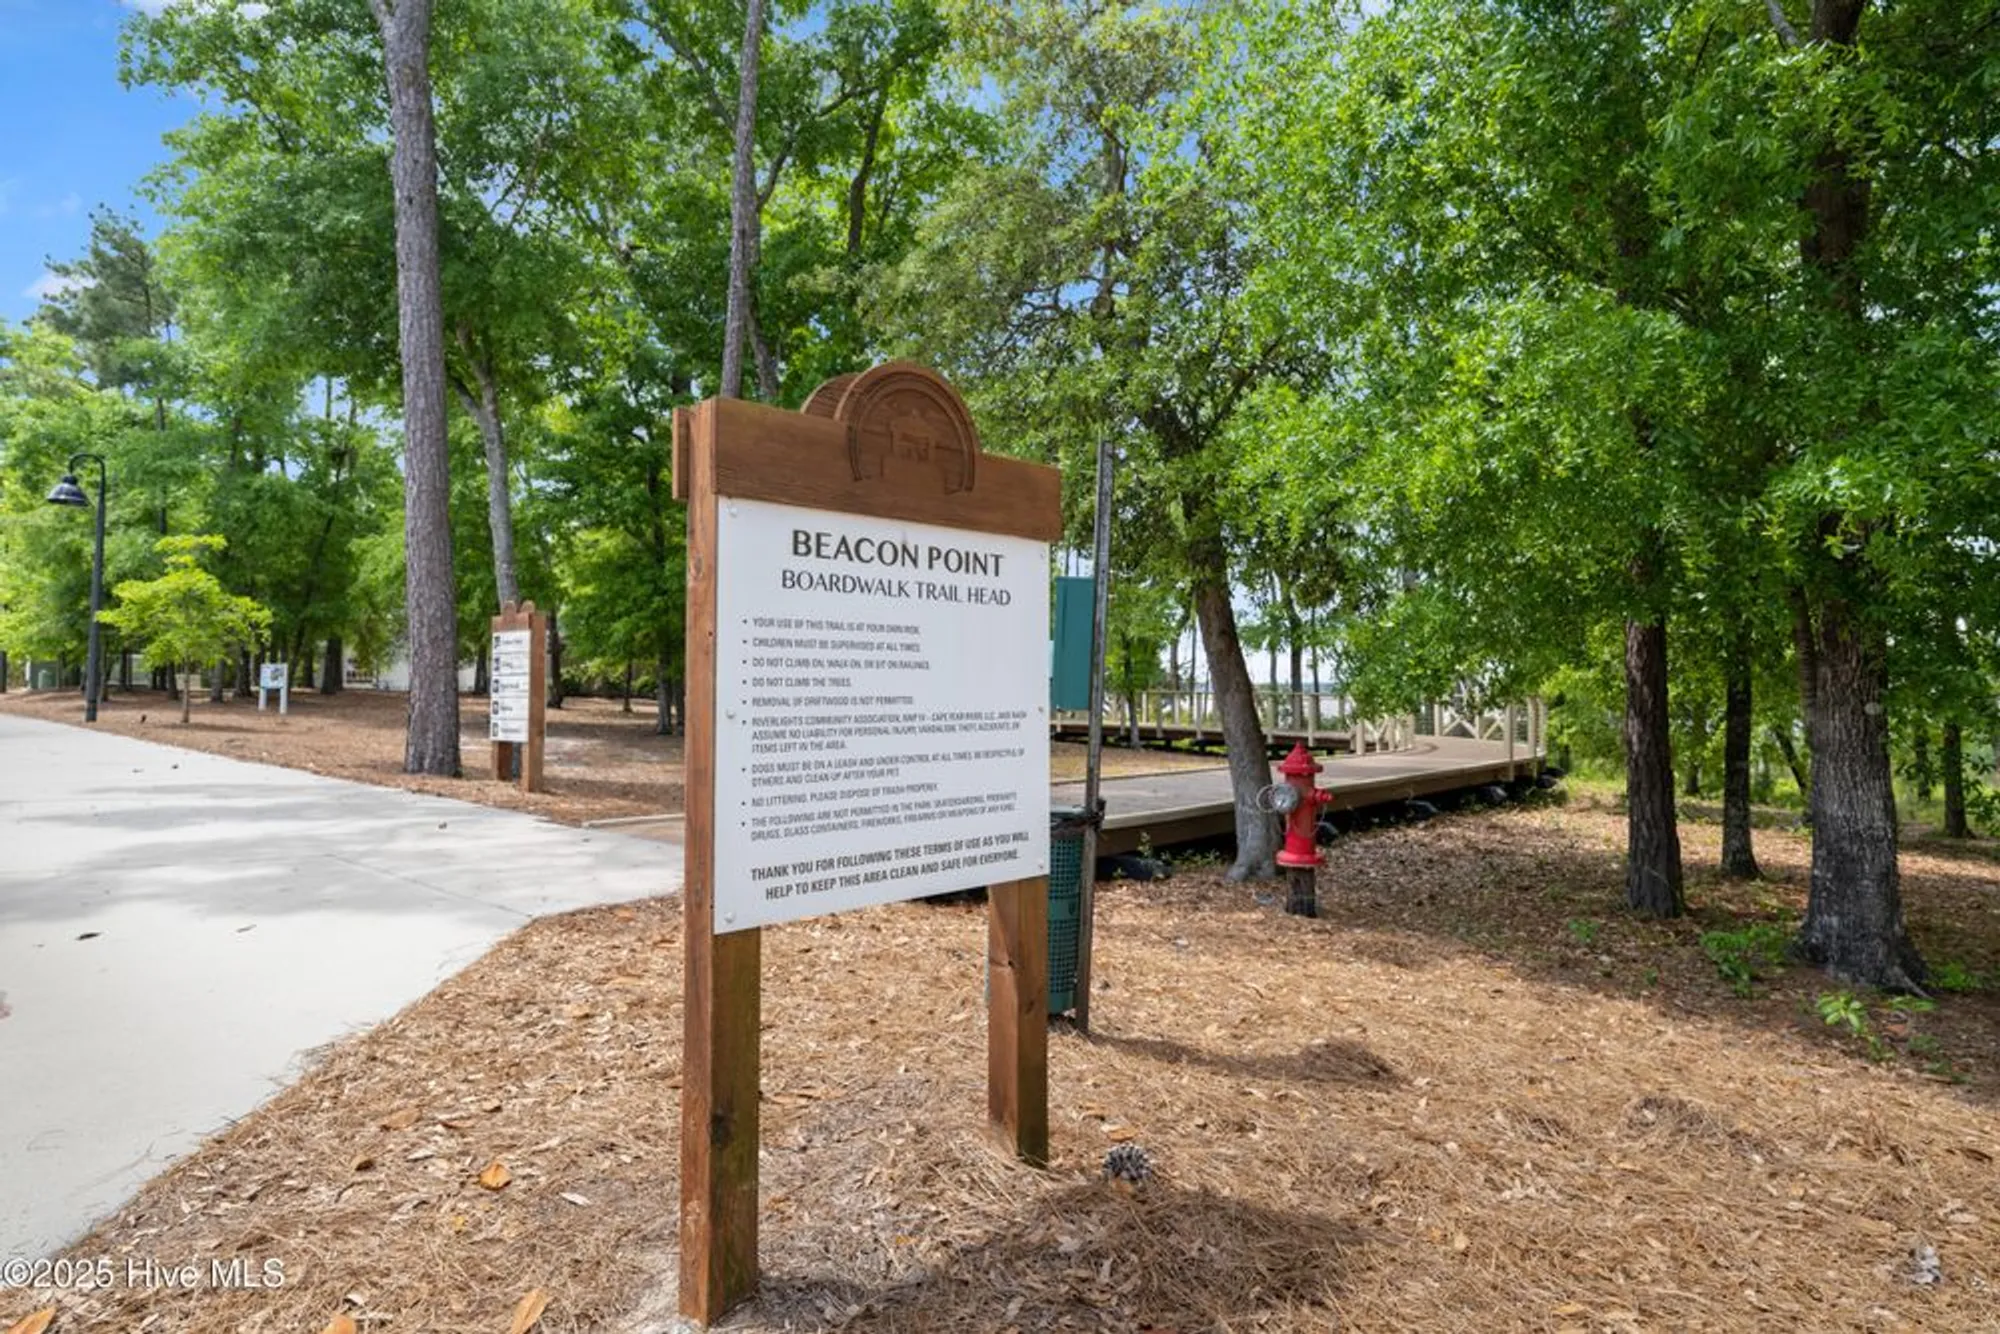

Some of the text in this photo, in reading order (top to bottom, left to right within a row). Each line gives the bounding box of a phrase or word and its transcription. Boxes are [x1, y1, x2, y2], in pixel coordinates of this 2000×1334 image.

[791, 528, 1004, 578] BEACON POINT
[781, 568, 1011, 606] BOARDWALK TRAIL HEAD
[752, 616, 774, 628] YOUR
[776, 617, 792, 628] USE
[793, 618, 803, 629] OF
[805, 619, 822, 630] THIS
[825, 620, 845, 631] TRAIL
[846, 621, 854, 631] IS
[855, 622, 864, 632] AT
[866, 622, 884, 633] YOUR
[885, 623, 903, 633] OWN
[752, 636, 792, 648] CHILDREN
[793, 638, 817, 648] MUST
[818, 639, 828, 649] BE
[829, 639, 874, 650] SUPERVISED
[876, 641, 884, 651] AT
[886, 641, 898, 651] ALL
[752, 656, 764, 667] DO
[766, 656, 783, 667] NOT
[784, 657, 810, 668] CLIMB
[825, 658, 848, 668] WALK
[864, 659, 873, 668] OR
[875, 659, 885, 669] SIT
[887, 659, 896, 669] ON
[752, 676, 764, 687] DO
[765, 676, 783, 687] NOT
[784, 676, 810, 687] CLIMB
[811, 677, 825, 687] THE
[752, 696, 790, 707] REMOVAL
[792, 696, 803, 706] OF
[803, 695, 849, 706] DRIFTWOOD
[850, 695, 858, 705] IS
[859, 695, 873, 705] NOT
[752, 715, 803, 726] RIVERLIGHTS
[804, 714, 852, 725] COMMUNITY
[931, 712, 947, 721] CAPE
[751, 729, 786, 740] ASSUME
[788, 728, 800, 739] NO
[802, 727, 838, 738] LIABILITY
[838, 727, 852, 737] FOR
[853, 726, 890, 736] PERSONAL
[751, 742, 777, 754] ITEMS
[779, 741, 797, 752] LEFT
[798, 741, 808, 751] IN
[809, 740, 823, 751] THE
[751, 762, 775, 774] DOGS
[777, 761, 800, 772] MUST
[802, 760, 811, 770] BE
[813, 759, 825, 770] ON
[826, 759, 833, 769] A
[834, 757, 857, 768] LEASH
[858, 756, 874, 767] AND
[876, 755, 899, 765] UNDER
[931, 753, 940, 762] AT
[940, 752, 951, 761] ALL
[751, 775, 784, 787] OTHERS
[785, 774, 802, 784] AND
[804, 772, 829, 783] CLEAN
[830, 771, 841, 781] UP
[843, 769, 865, 780] AFTER
[866, 768, 885, 778] YOUR
[751, 796, 764, 807] NO
[809, 790, 837, 801] PLEASE
[839, 787, 869, 799] DISPOSE
[871, 786, 880, 796] OF
[882, 784, 904, 795] TRASH
[751, 816, 766, 827] THE
[768, 811, 815, 826] FOLLOWING
[817, 809, 830, 820] ARE
[832, 808, 848, 819] NOT
[850, 804, 889, 817] PERMITTED
[891, 803, 899, 813] IN
[899, 801, 912, 812] THE
[783, 824, 809, 837] GLASS
[948, 806, 979, 818] WEAPONS
[751, 830, 1029, 880] THANK YOU FOR FOLLOWING THESE TERMS OF USE AS YOU WILL
[765, 883, 793, 900] HELP
[794, 881, 809, 895] TO
[809, 876, 836, 893] KEEP
[837, 873, 861, 888] THIS
[862, 869, 888, 884] AREA
[889, 864, 918, 880] CLEAN
[920, 861, 938, 875] AND
[939, 857, 961, 871] SAFE
[961, 855, 977, 868] FOR
